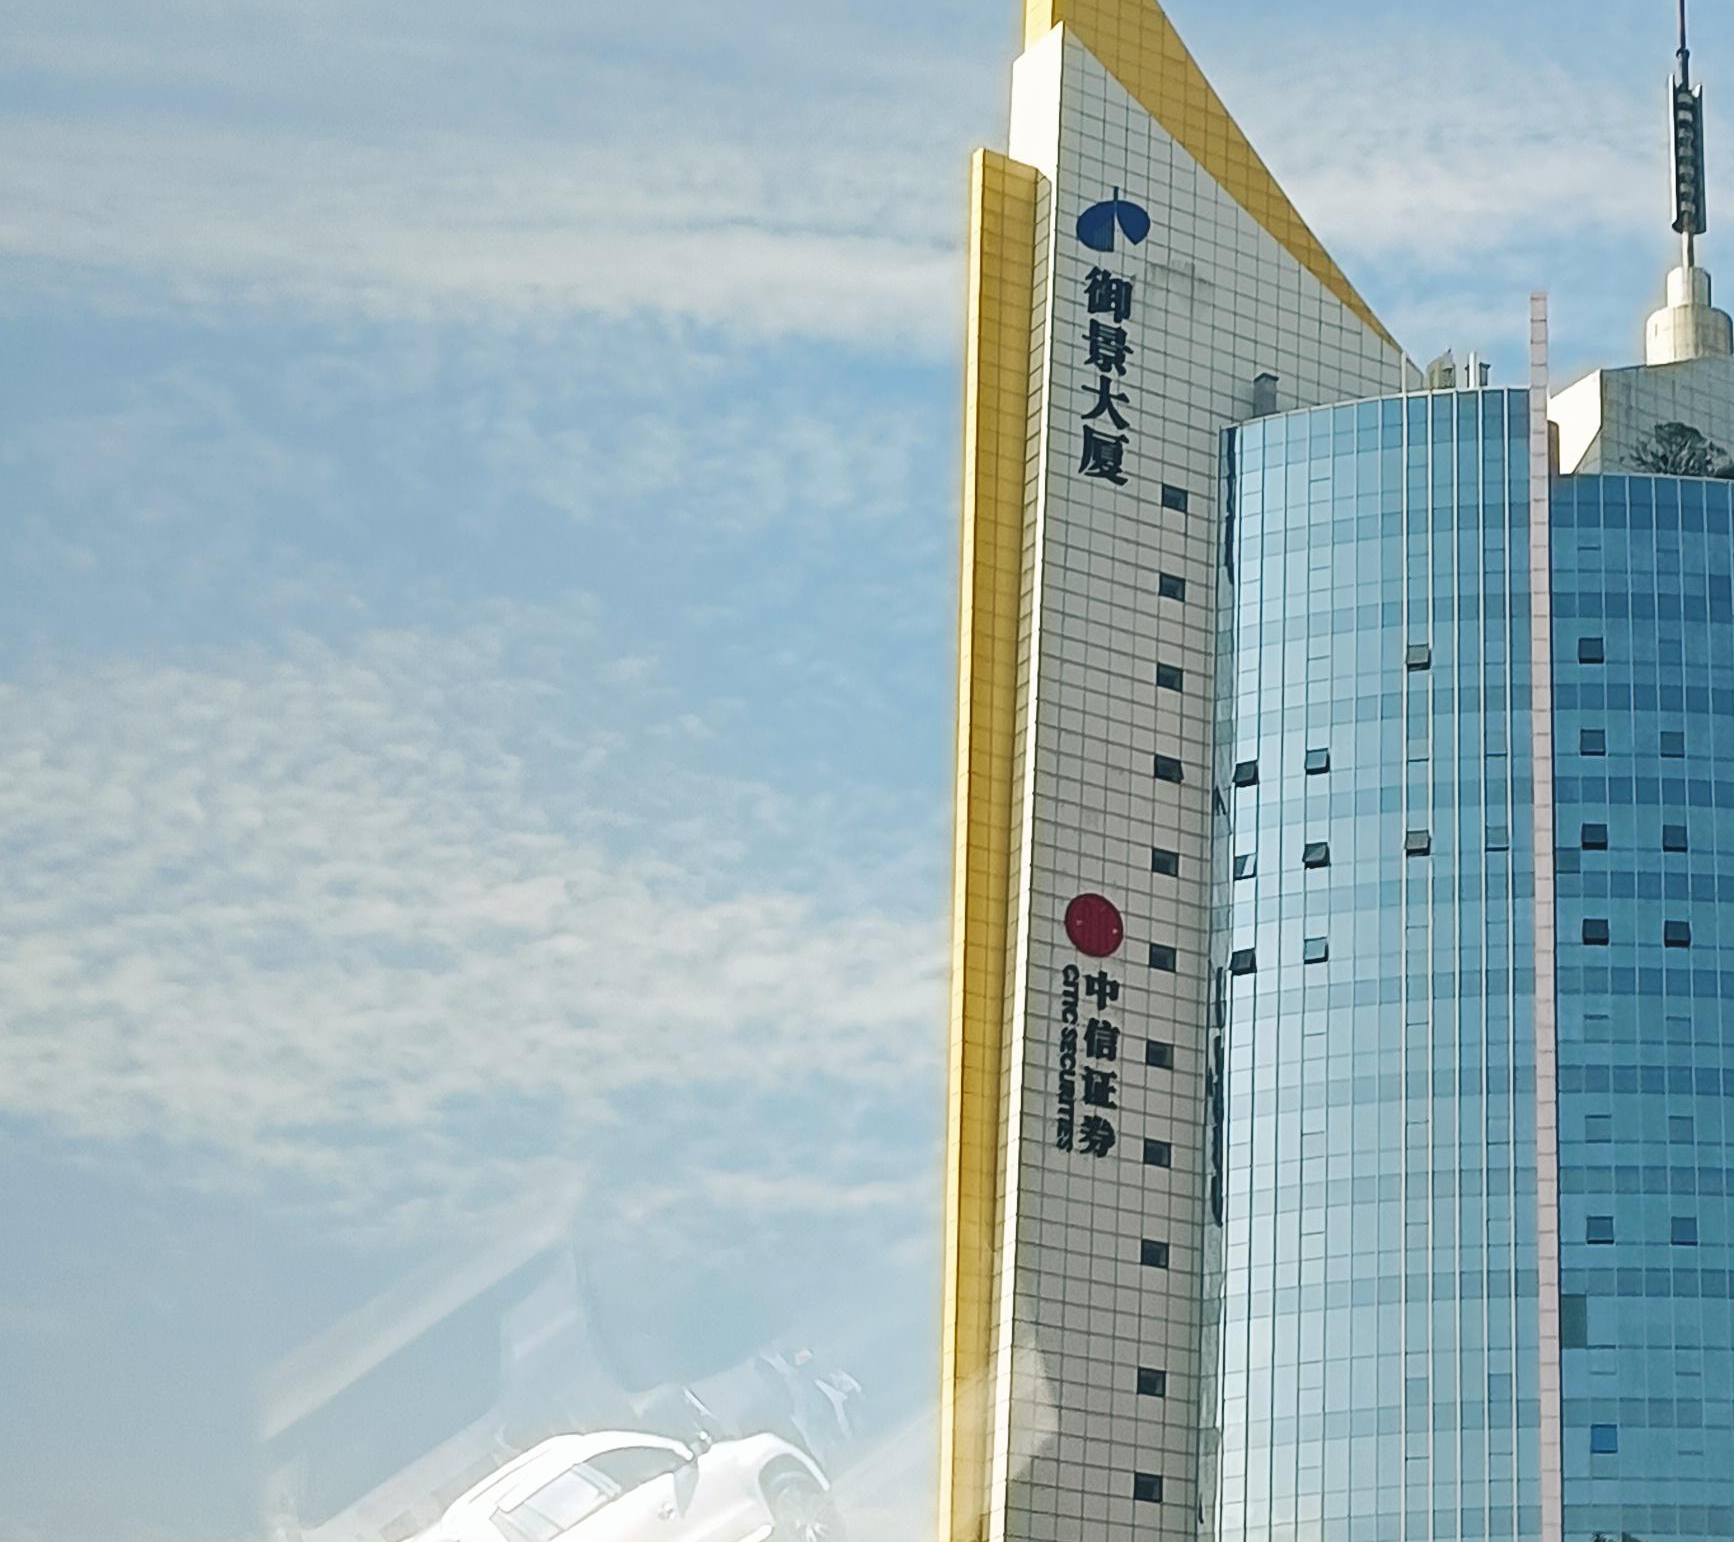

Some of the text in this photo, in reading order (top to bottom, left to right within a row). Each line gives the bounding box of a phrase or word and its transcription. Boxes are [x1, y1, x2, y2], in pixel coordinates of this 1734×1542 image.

[1078, 265, 1137, 486] 御景大厦
[1055, 963, 1080, 1153] CITIC SECURITIES
[1079, 970, 1121, 1158] 中信证券
